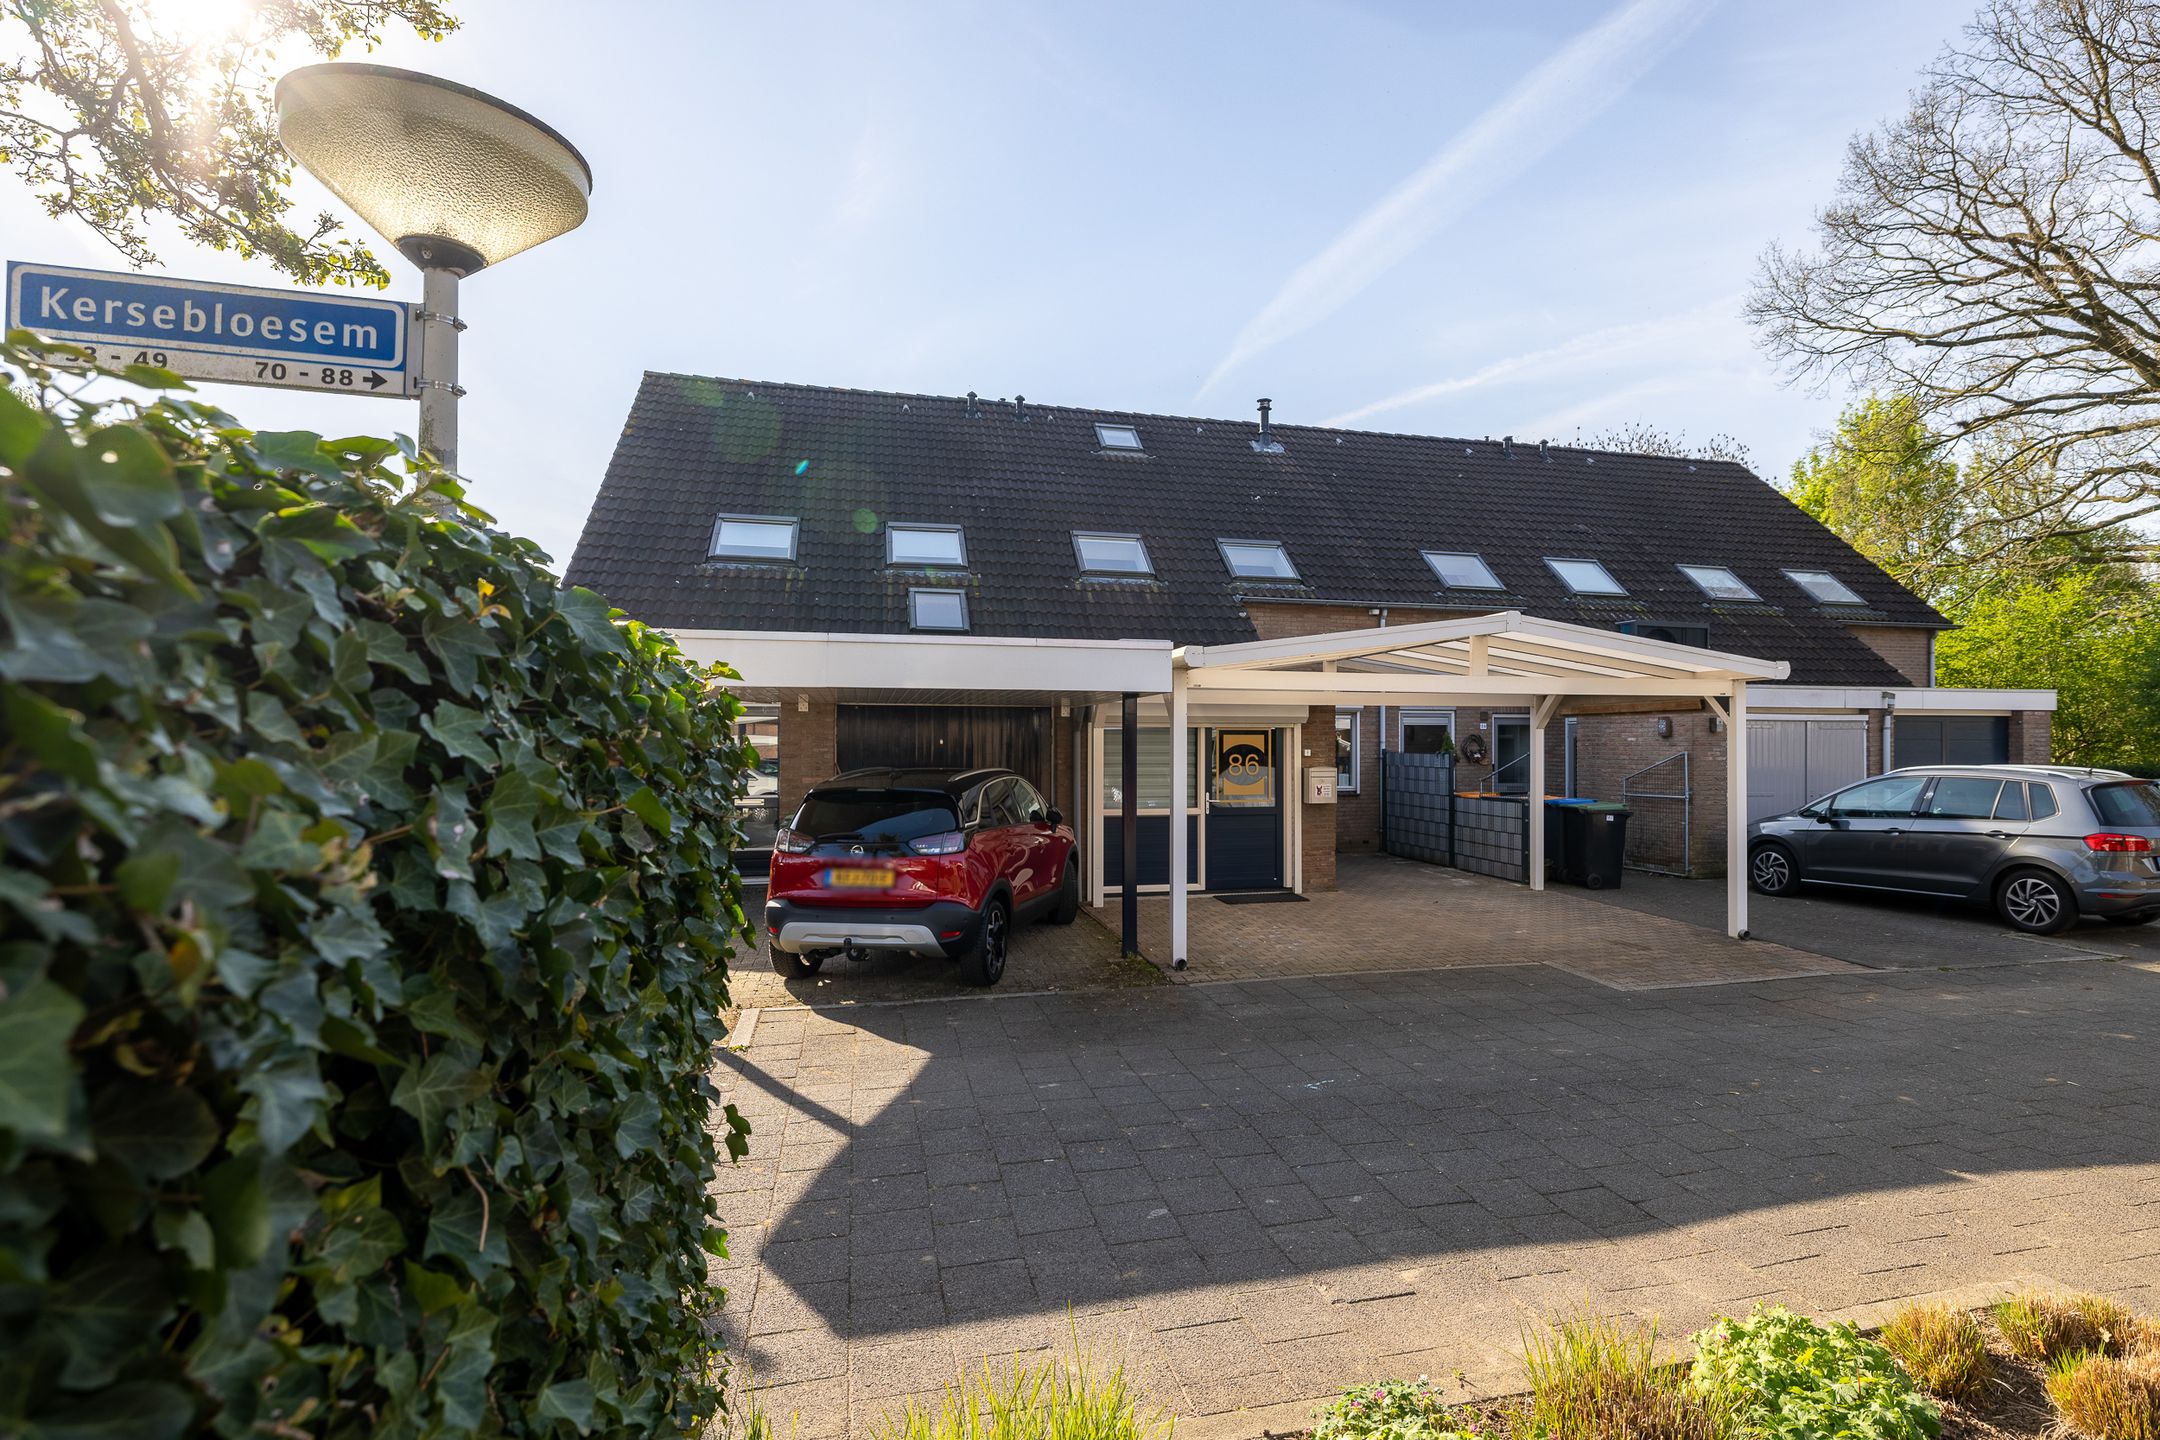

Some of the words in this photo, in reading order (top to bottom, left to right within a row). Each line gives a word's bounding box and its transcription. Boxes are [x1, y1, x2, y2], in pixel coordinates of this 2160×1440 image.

[40, 285, 378, 350] Kersebloesem
[133, 351, 168, 368] 49
[255, 361, 287, 380] 70
[321, 367, 353, 386] 88
[1228, 753, 1259, 776] 86
